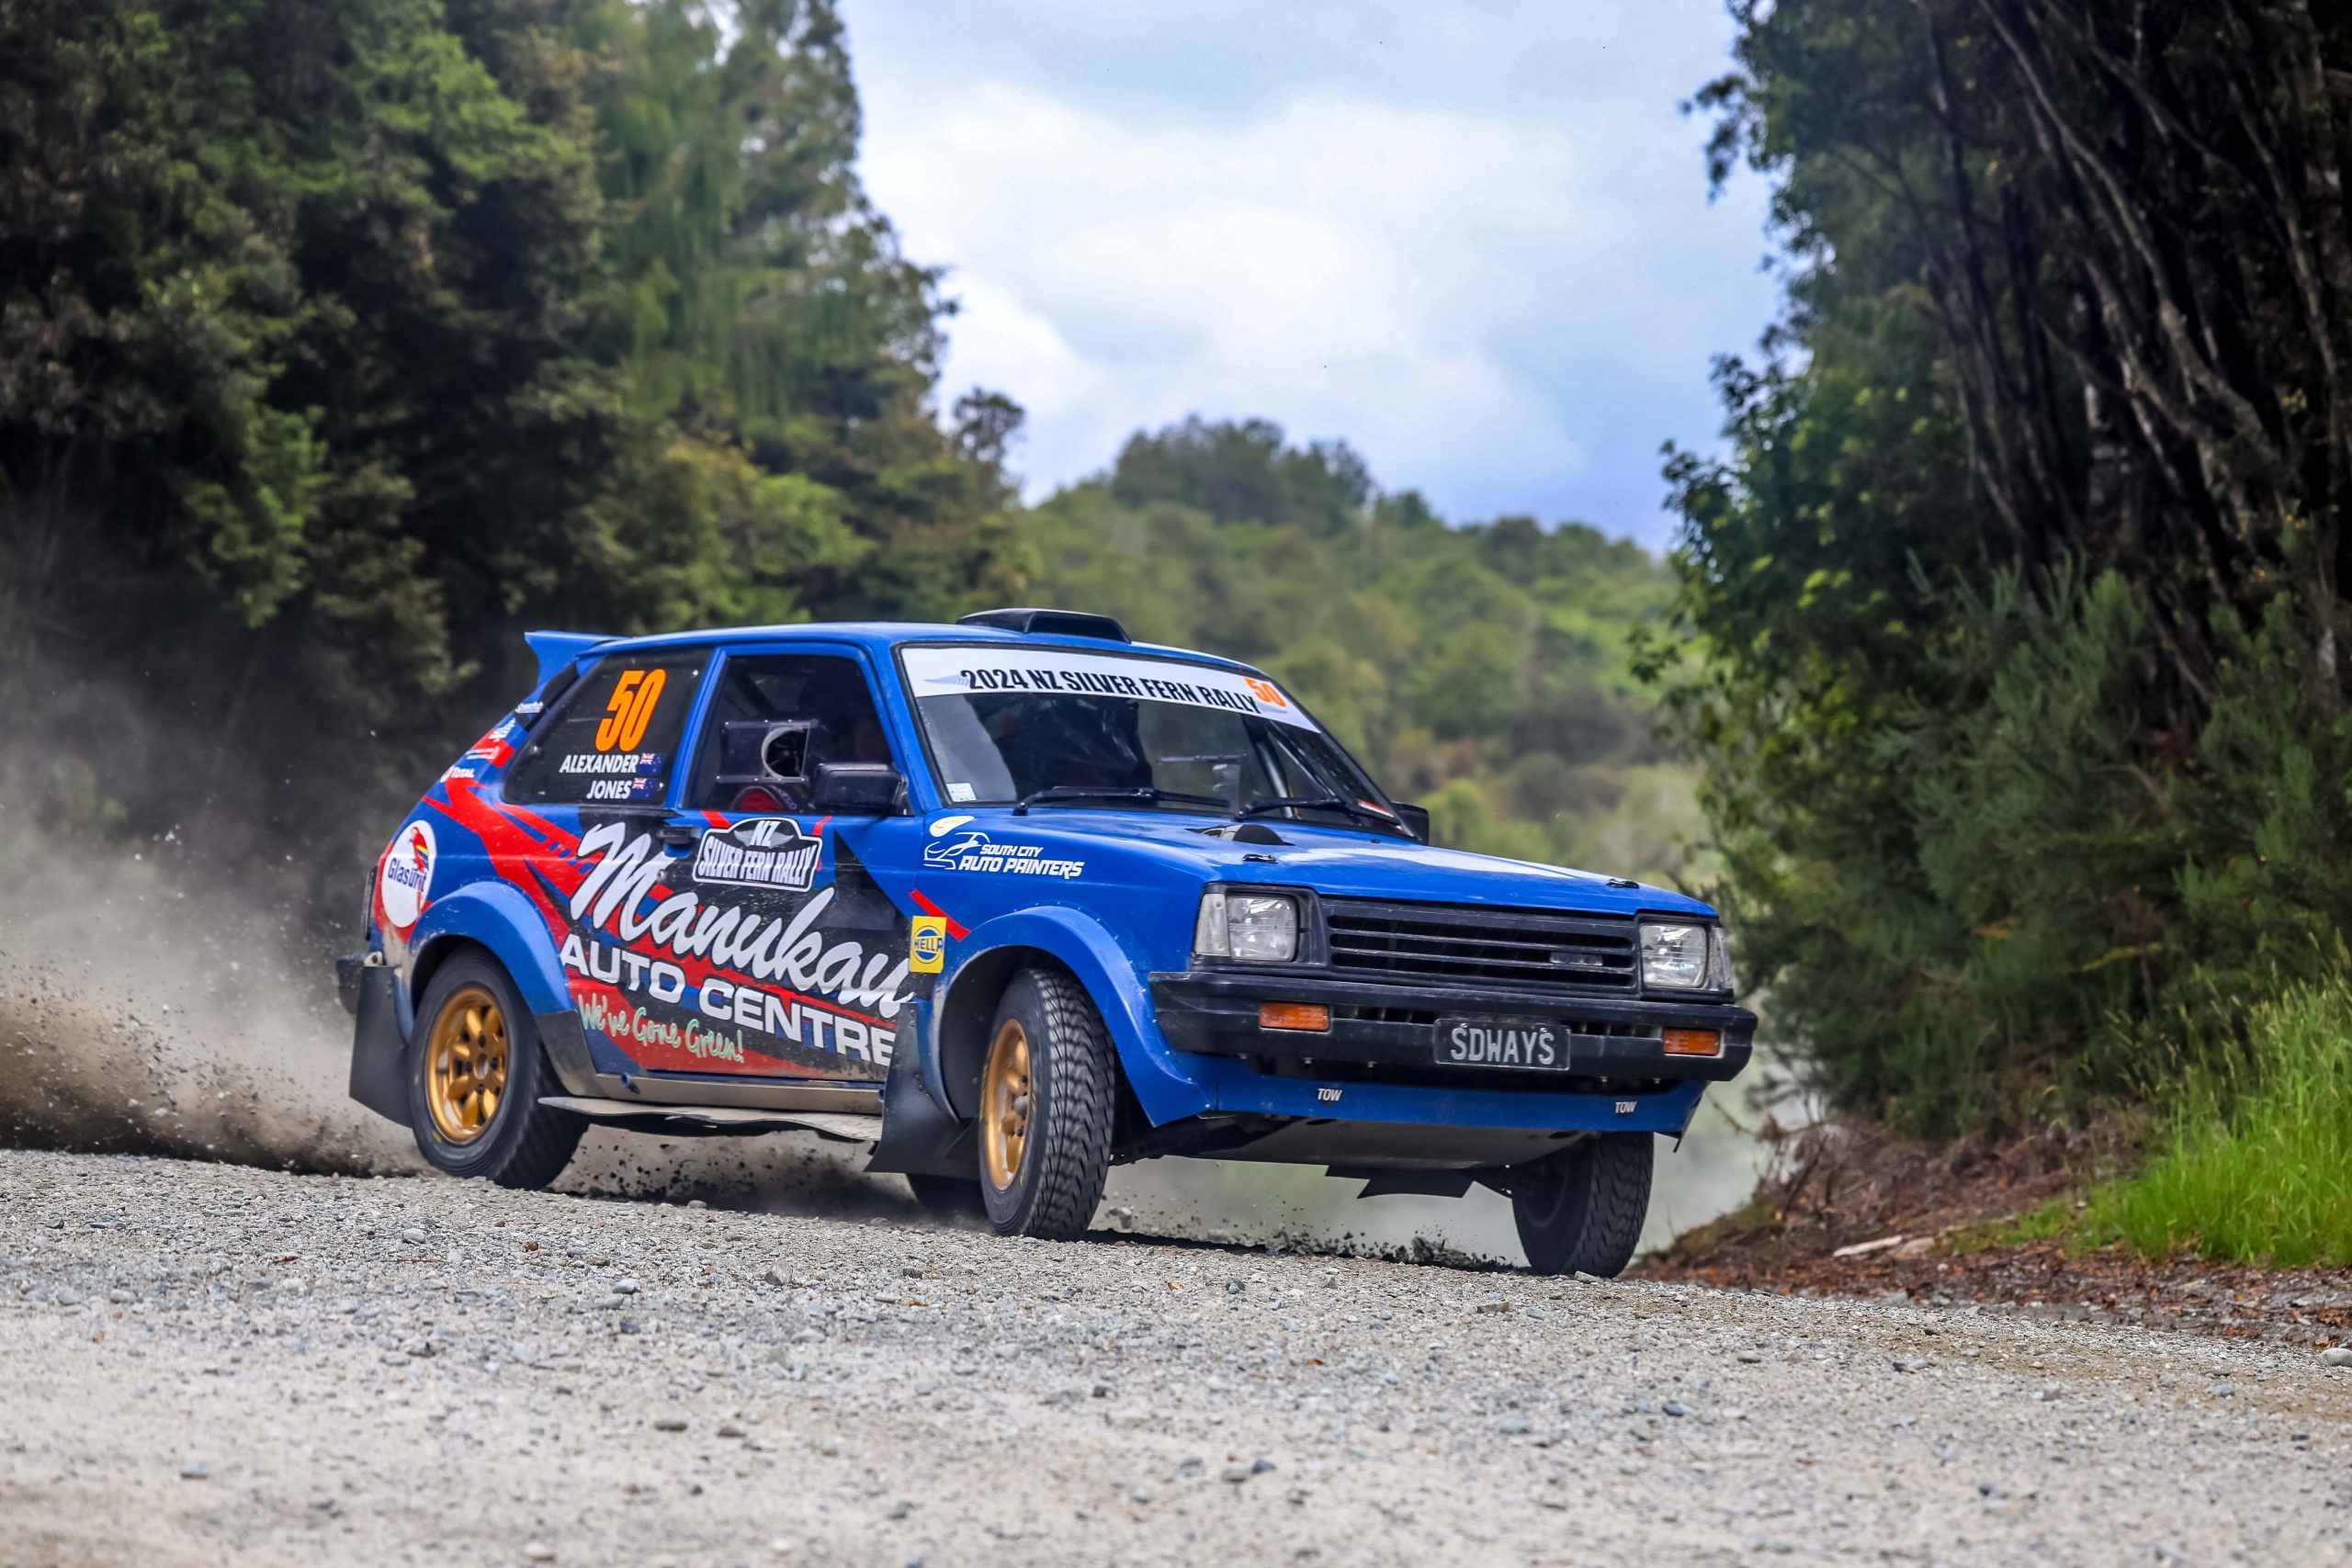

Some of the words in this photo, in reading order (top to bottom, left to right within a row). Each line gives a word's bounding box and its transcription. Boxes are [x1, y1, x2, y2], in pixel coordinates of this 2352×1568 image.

[960, 670, 1029, 689] 2024
[1026, 670, 1063, 690] NZ
[1060, 671, 1144, 695] SILVER
[1139, 678, 1201, 704] FERN
[1196, 685, 1261, 714] RALLY
[1243, 676, 1287, 708] 50
[595, 669, 667, 752] 50
[559, 754, 640, 773] ALEXANDER
[586, 780, 632, 799] JONES
[750, 820, 781, 847] NZ
[698, 836, 743, 878] SILVER
[740, 850, 775, 882] FERN
[771, 845, 818, 886] RALLY
[979, 844, 1018, 856] SOUTH
[1017, 846, 1044, 857] CITY
[958, 855, 1004, 872] AUTO
[1002, 857, 1085, 879] PAINTERS
[570, 822, 915, 1018] Manukau
[913, 937, 944, 953] HELLA
[560, 934, 685, 1004] AUTO
[699, 979, 896, 1066] CENTRE
[578, 993, 629, 1037] We've
[632, 1007, 682, 1049] Gone
[685, 1019, 745, 1064] Green!
[1450, 1027, 1555, 1066] SDWAYS
[1317, 1088, 1342, 1101] TOW
[1615, 1101, 1637, 1113] TOW
